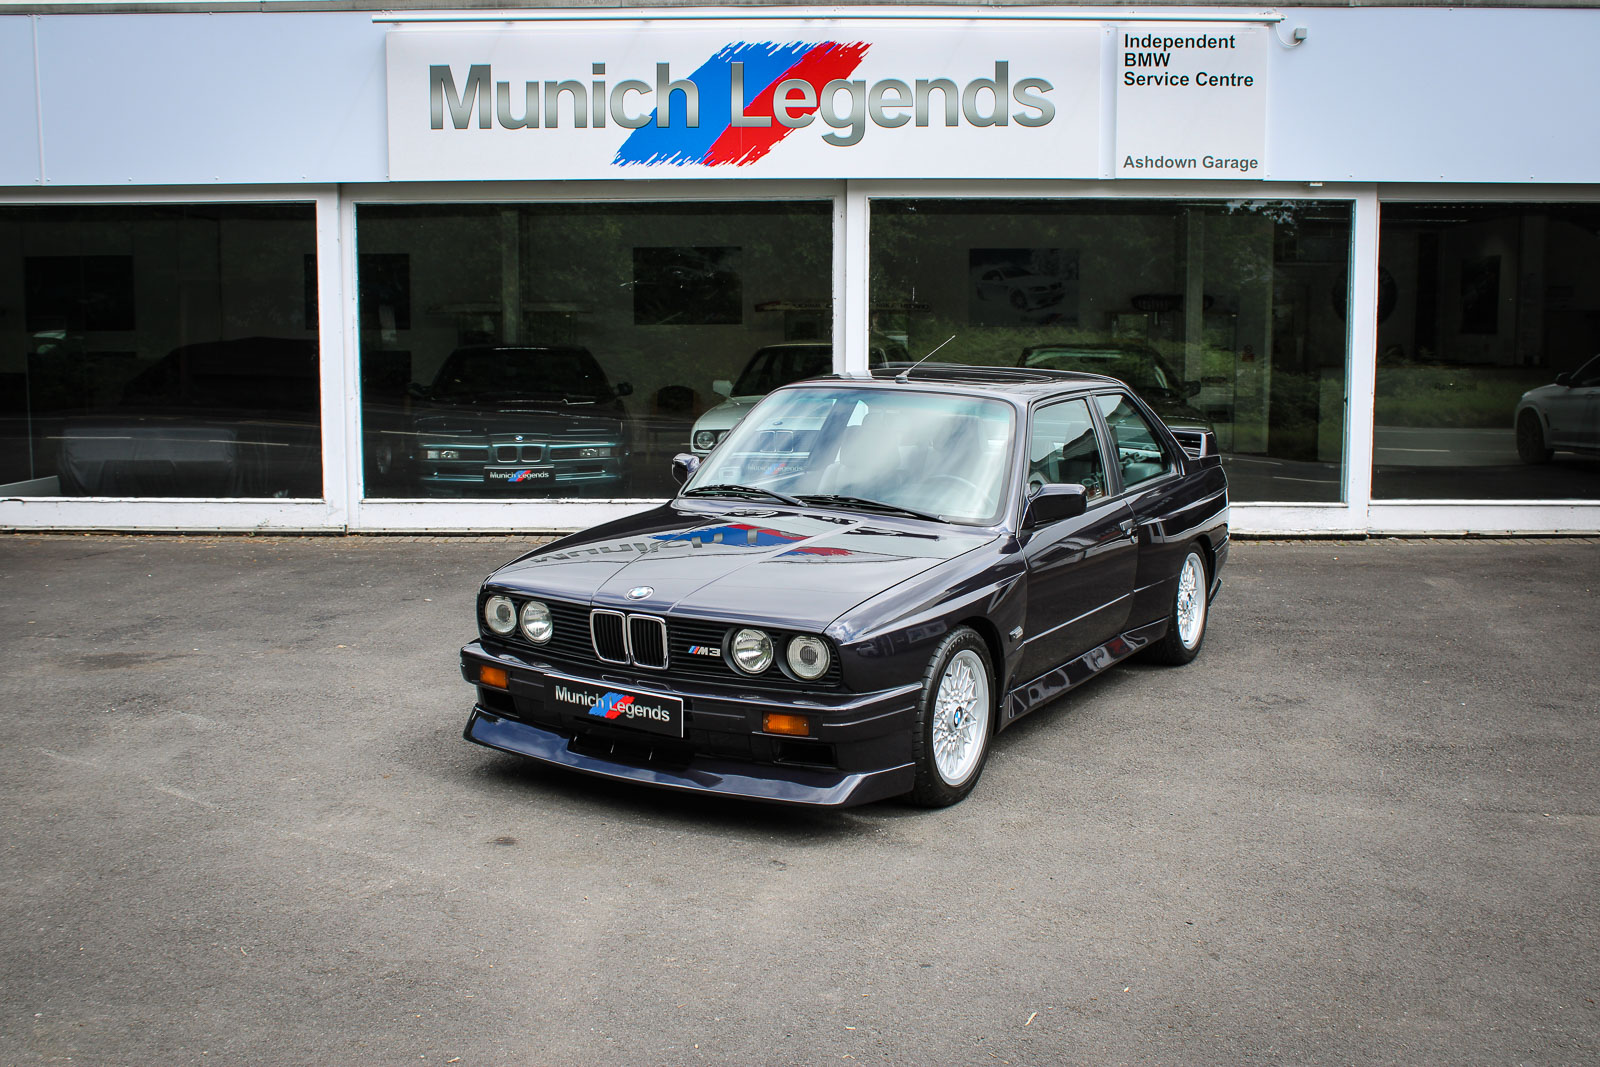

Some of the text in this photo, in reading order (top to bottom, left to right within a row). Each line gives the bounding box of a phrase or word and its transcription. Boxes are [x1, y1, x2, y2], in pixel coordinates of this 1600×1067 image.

[1124, 33, 1235, 51] Independent
[1124, 53, 1171, 67] BMW
[1123, 71, 1254, 87] Service Centre
[429, 60, 1056, 147] Munich Legends
[1123, 155, 1259, 172] Ashdown Garage
[518, 471, 550, 480] Legends
[697, 646, 721, 657] M3
[555, 685, 670, 722] Munich Legends
